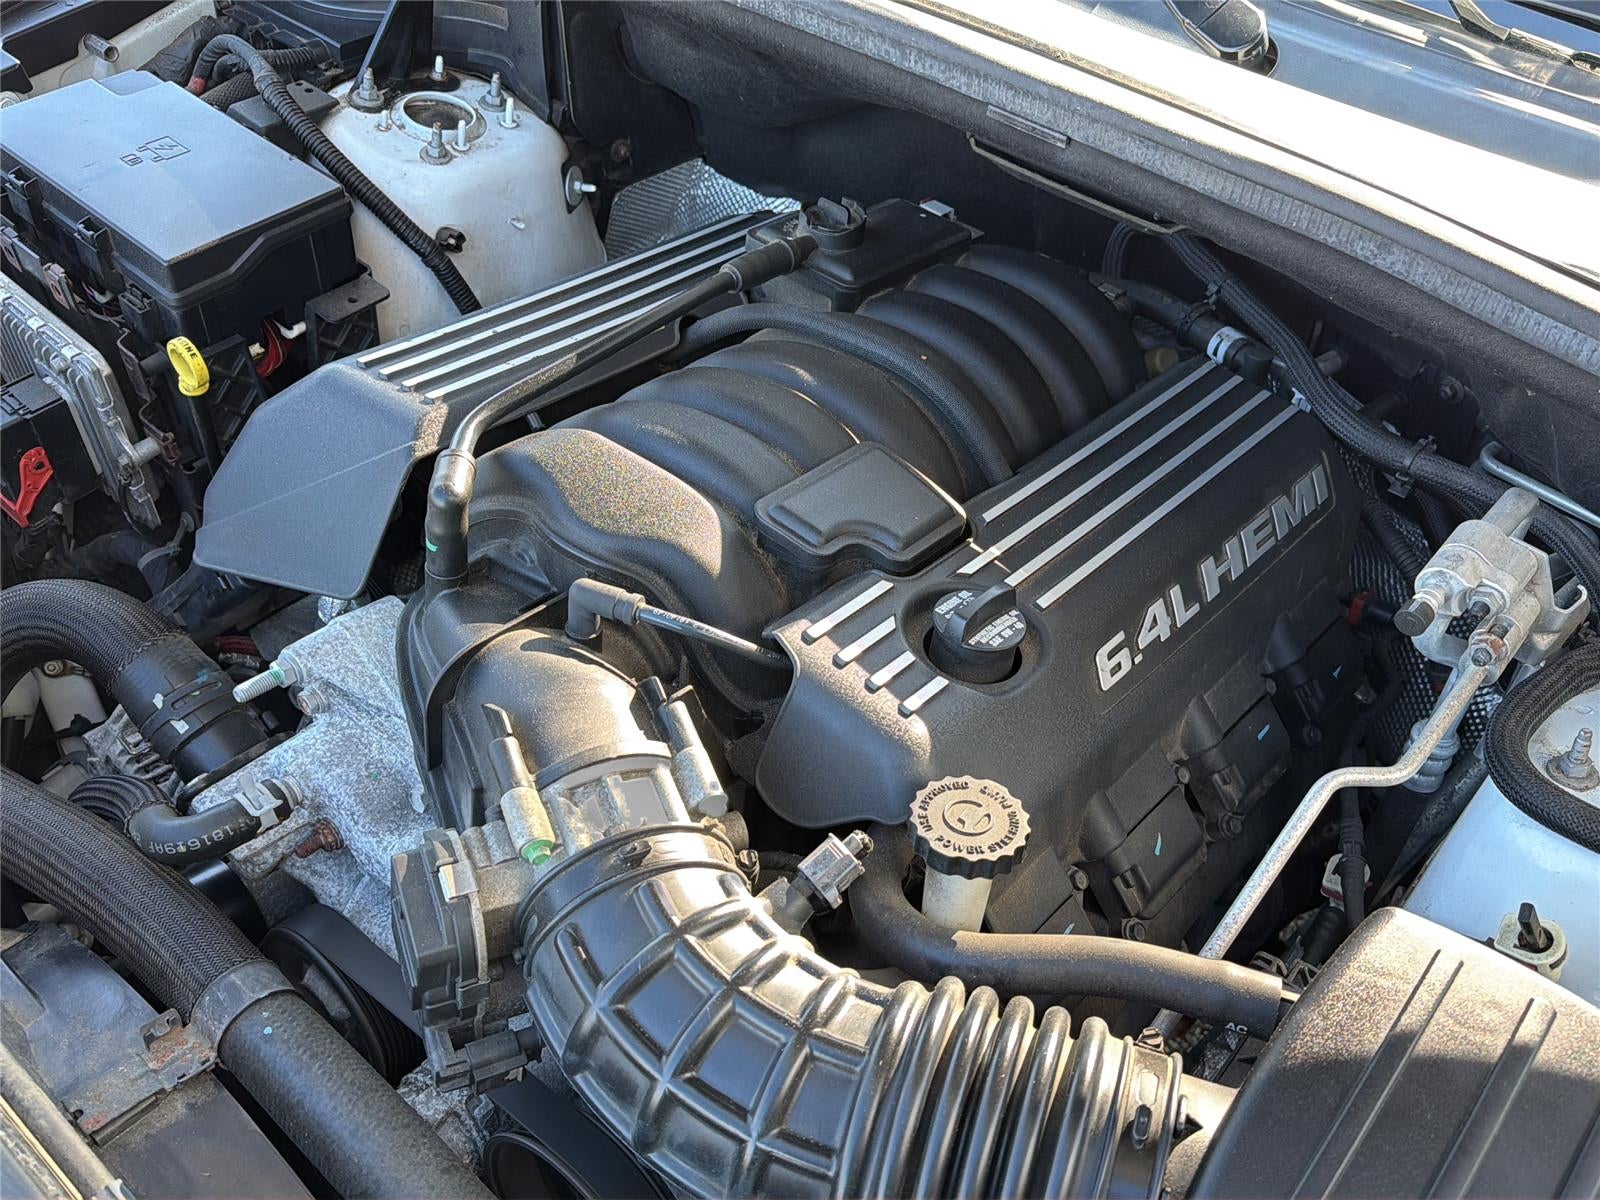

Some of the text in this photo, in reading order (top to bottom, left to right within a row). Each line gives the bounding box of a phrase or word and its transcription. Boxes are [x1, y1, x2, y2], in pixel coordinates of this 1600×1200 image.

[1094, 463, 1330, 692] 6.4L HEMI
[933, 834, 986, 856] POWER
[1224, 1022, 1248, 1034] AC
